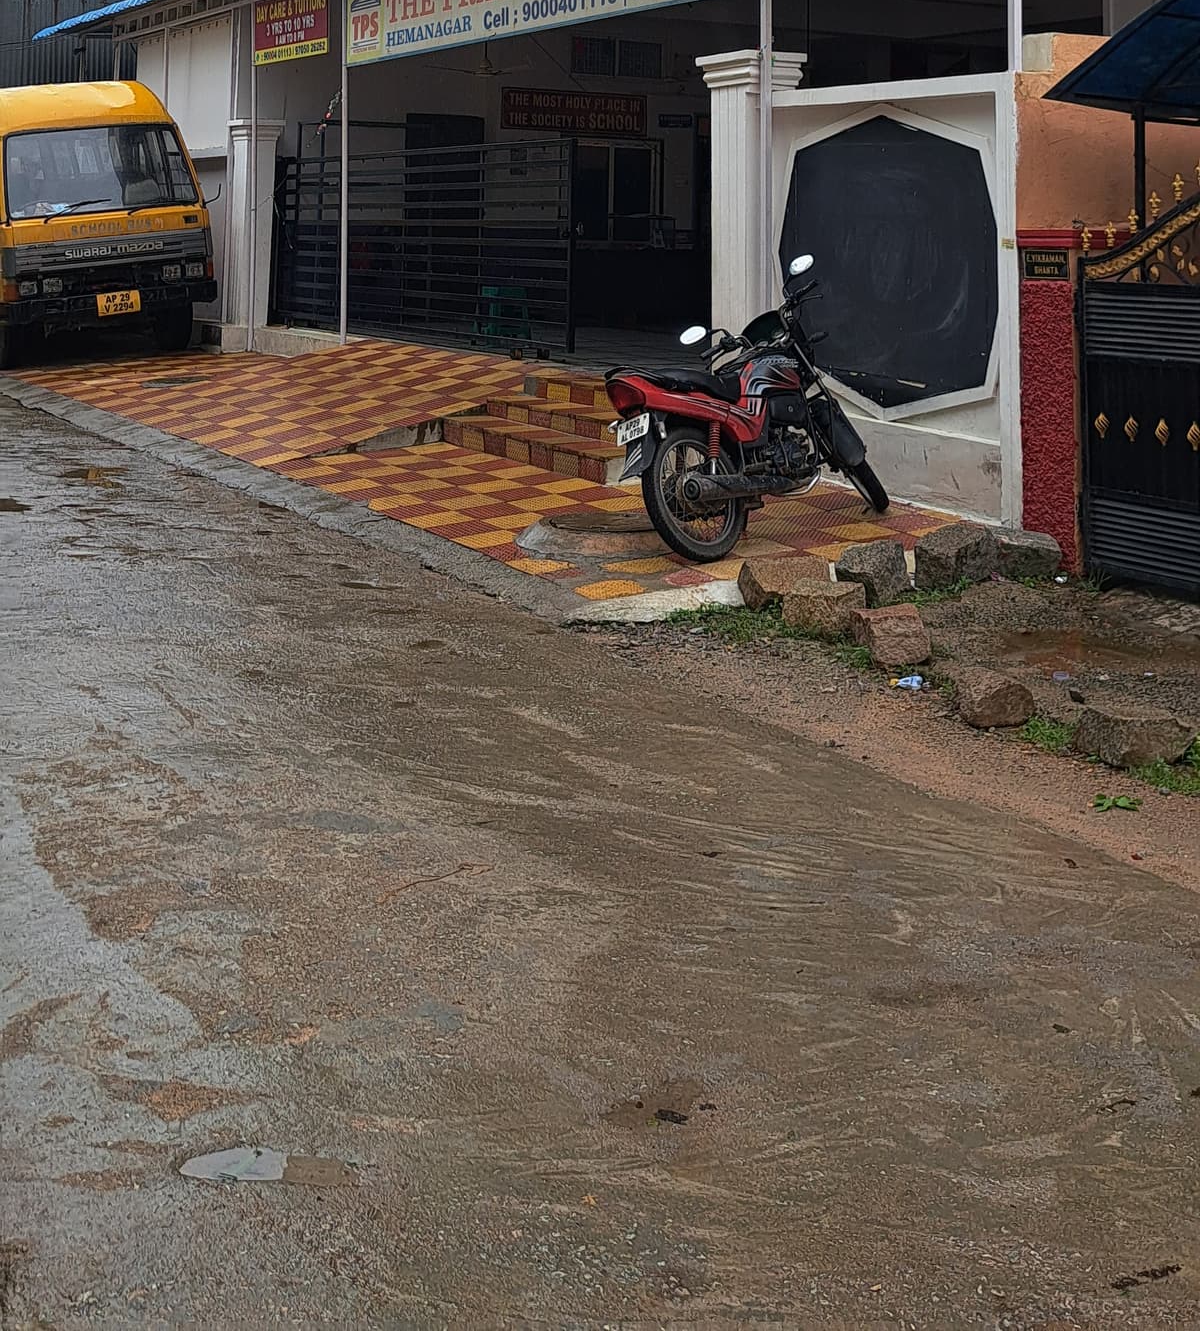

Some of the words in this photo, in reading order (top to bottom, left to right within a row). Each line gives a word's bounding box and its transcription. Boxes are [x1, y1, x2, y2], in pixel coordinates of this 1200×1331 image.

[256, 6, 269, 23] DAY
[269, 2, 286, 20] CARE
[287, 0, 293, 16] &
[271, 20, 283, 35] YRS
[284, 19, 293, 33] TO
[293, 16, 301, 31] 10
[302, 14, 315, 30] YRS
[351, 11, 379, 41] TPS
[385, 15, 472, 47] HEMANAGAR
[483, 6, 509, 30] Cell
[509, 92, 529, 106] THE
[533, 94, 562, 108] MOST
[565, 97, 592, 109] HOLY
[594, 98, 626, 111] PLACE
[630, 99, 640, 111] IN
[509, 112, 529, 125] THE
[531, 114, 573, 127] SOCIETY
[576, 117, 585, 128] IS
[588, 113, 641, 131] SCHOOL
[71, 222, 122, 236] SCHOOL
[104, 304, 111, 313] V
[113, 301, 134, 312] 2294
[105, 295, 117, 304] AP
[119, 293, 130, 302] 29
